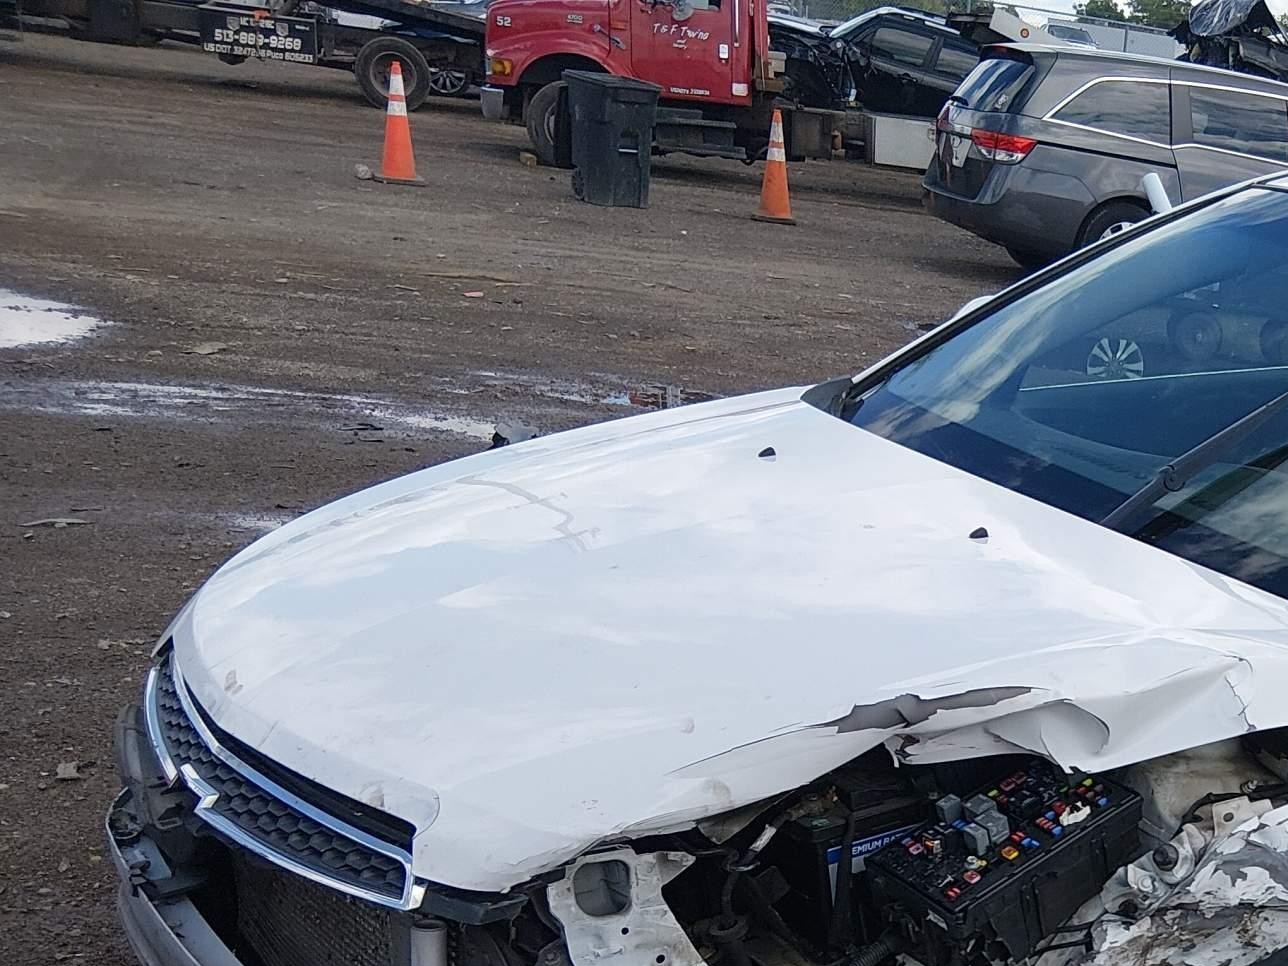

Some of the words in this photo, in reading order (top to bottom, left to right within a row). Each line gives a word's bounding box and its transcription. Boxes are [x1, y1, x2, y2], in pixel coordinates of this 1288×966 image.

[496, 15, 512, 27] 52
[653, 23, 661, 33] T
[670, 24, 678, 35] F
